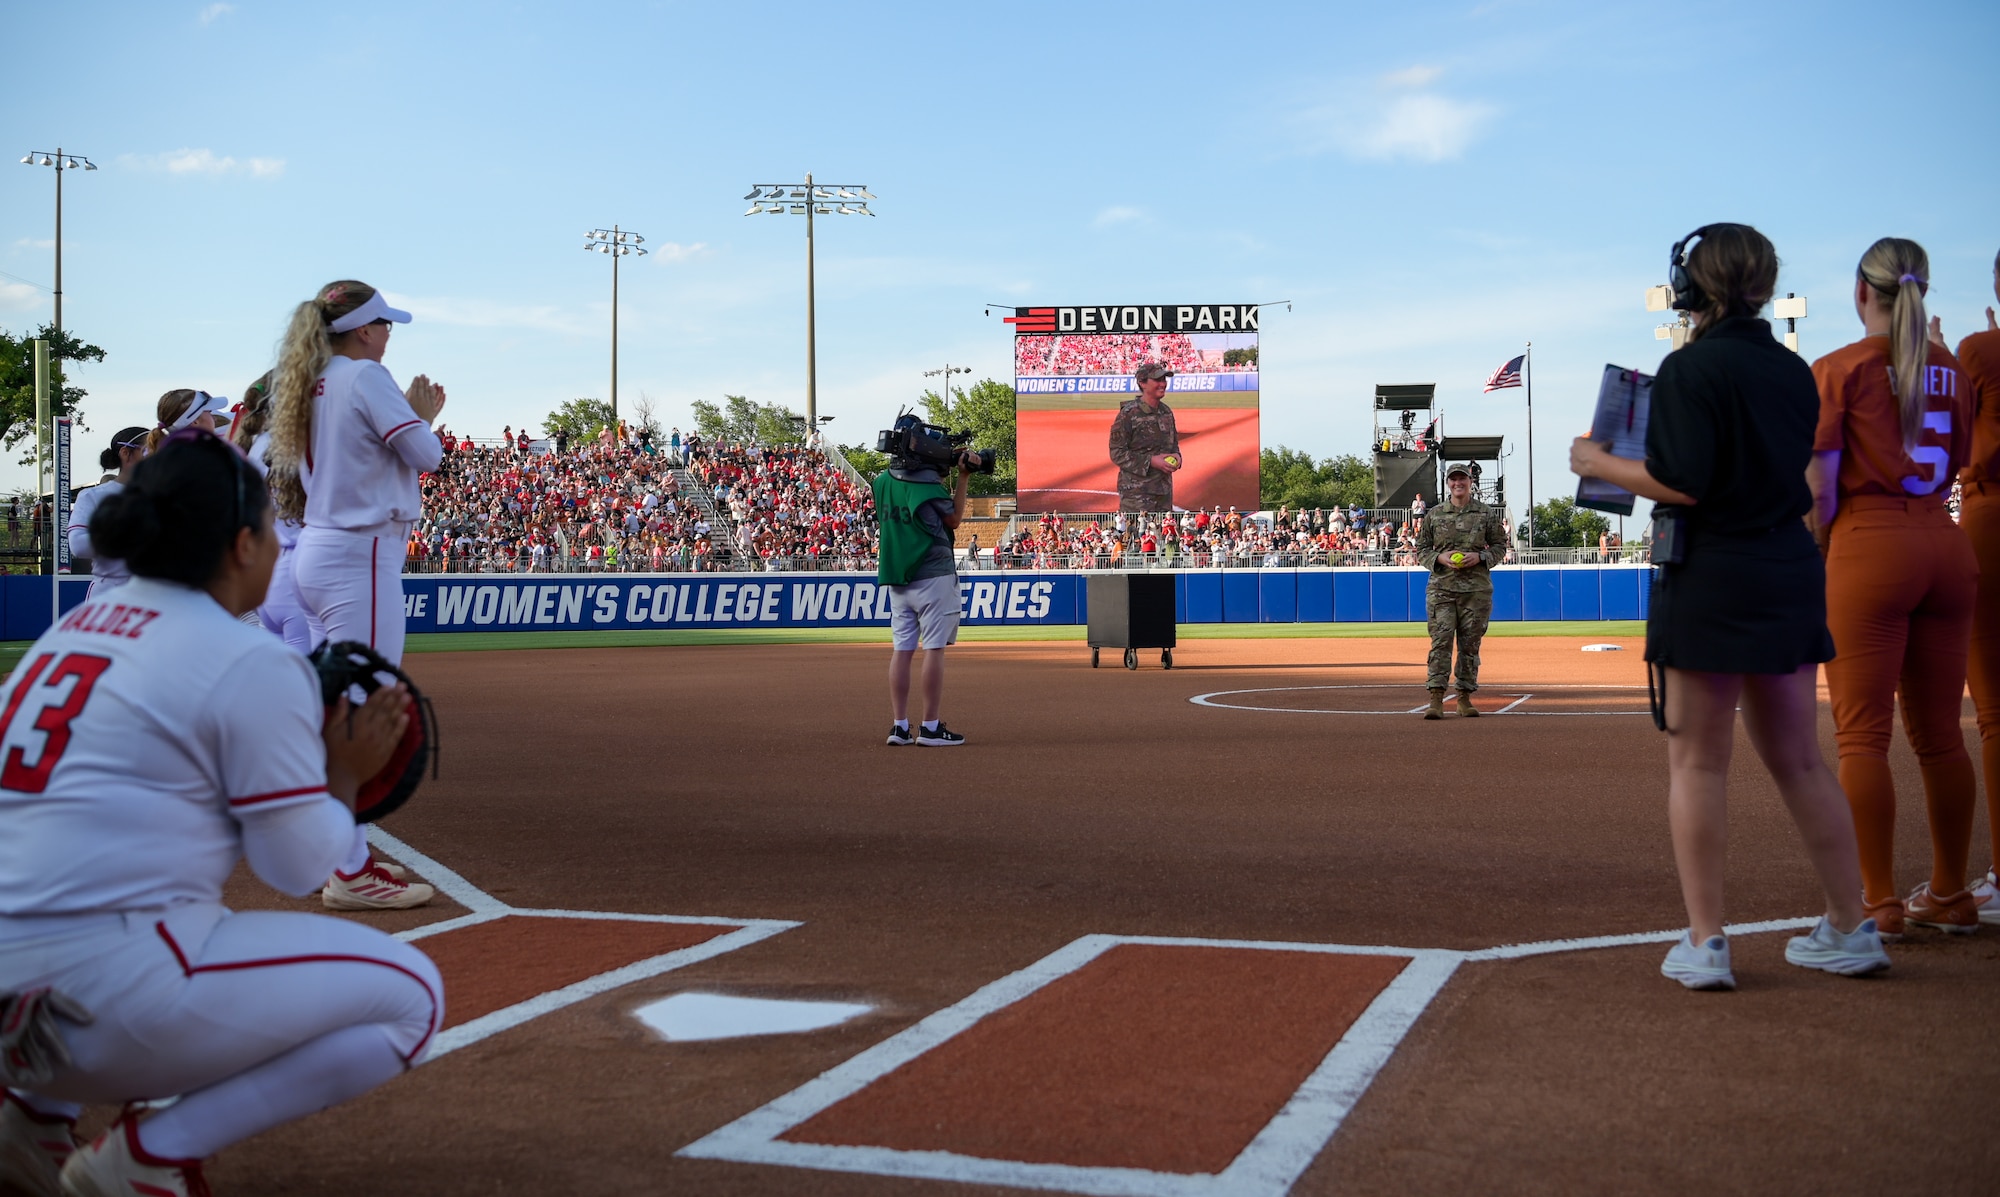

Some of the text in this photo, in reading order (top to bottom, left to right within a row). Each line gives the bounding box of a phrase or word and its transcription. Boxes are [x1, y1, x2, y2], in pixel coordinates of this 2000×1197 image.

[1058, 305, 1258, 331] DEVON PARK
[1017, 378, 1076, 393] WOMEN'S
[1077, 377, 1127, 392] COLLEGE
[1173, 376, 1216, 391] SERIES
[60, 425, 69, 445] NCAA
[60, 446, 69, 480] WOMEN'S
[1901, 411, 1951, 496] 5
[60, 481, 69, 511] COLLEGE
[60, 538, 69, 564] SERIES
[404, 581, 1053, 625] HE WOMEN'S COLLEGE WORL ERIES
[0, 652, 113, 795] 13
